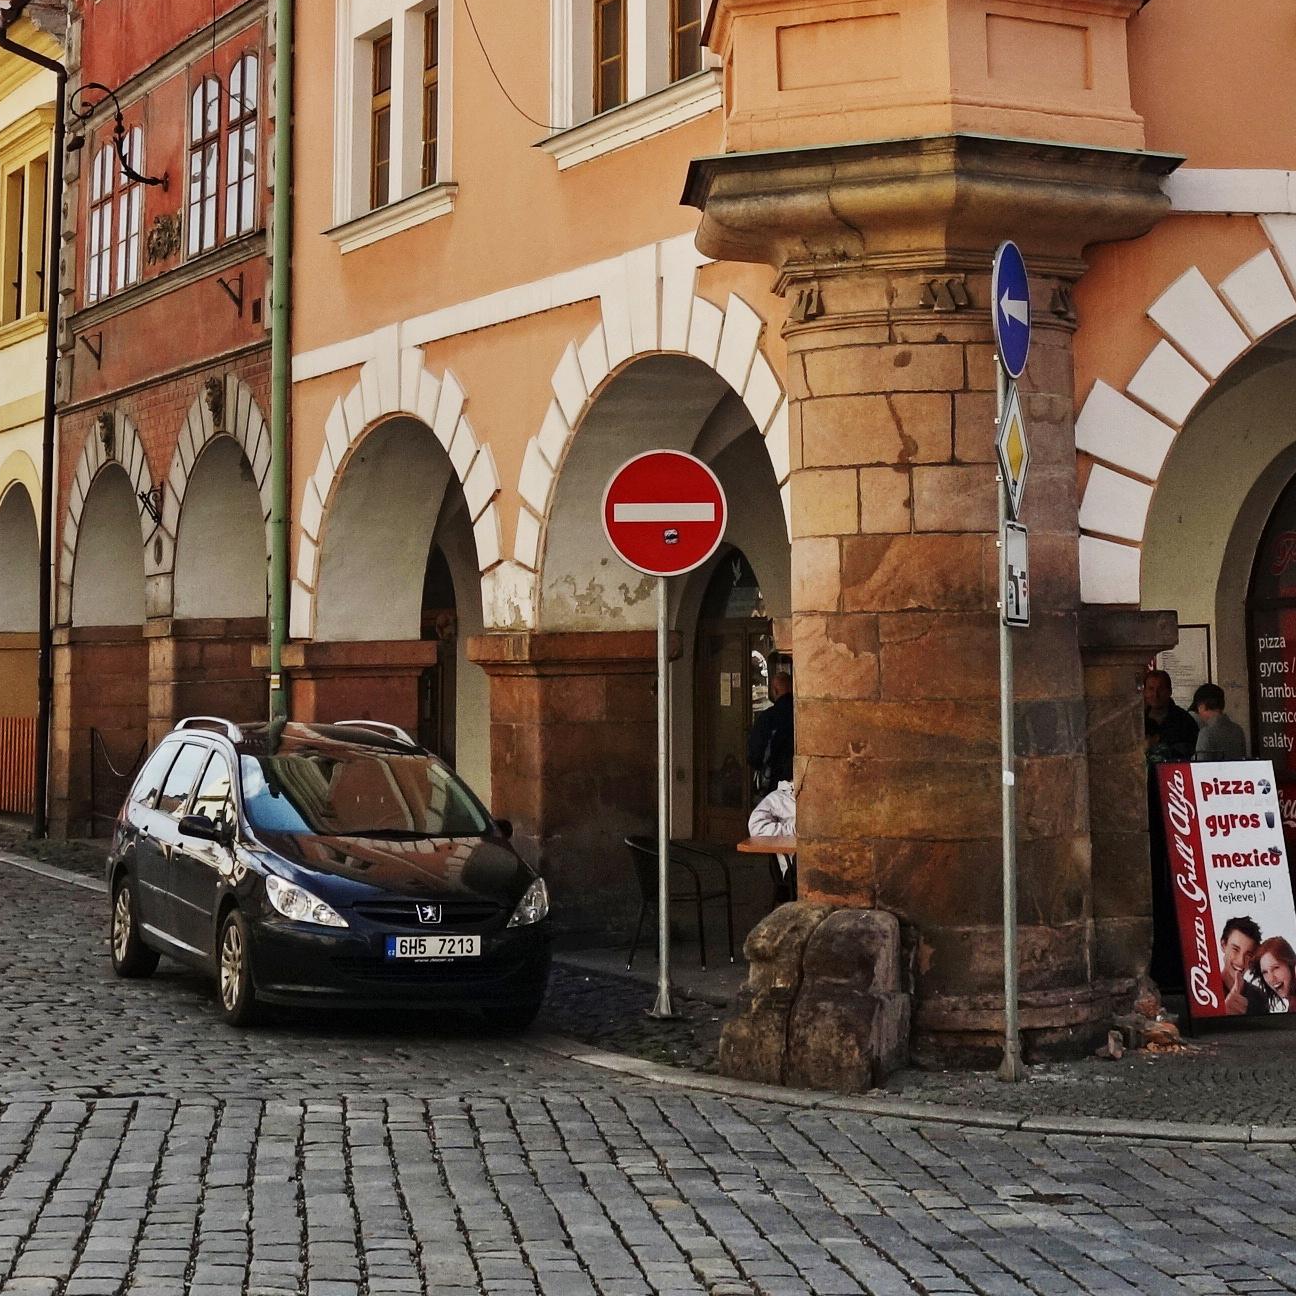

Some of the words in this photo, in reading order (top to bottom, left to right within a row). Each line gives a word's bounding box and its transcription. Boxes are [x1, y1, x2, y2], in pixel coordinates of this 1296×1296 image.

[1258, 633, 1286, 652] pizza
[1259, 661, 1289, 677] gyros
[1263, 733, 1294, 752] saláty
[1200, 777, 1255, 802] pizza
[1166, 769, 1196, 836] Alfa
[1205, 813, 1261, 837] gyros
[1212, 849, 1281, 868] mexico
[1176, 835, 1208, 913] Grill
[1216, 878, 1272, 890] Vychytanej
[1218, 892, 1257, 903] tejkevej
[399, 938, 427, 955] 6H5
[438, 937, 474, 954] 7213
[1190, 916, 1218, 1009] Pizza
